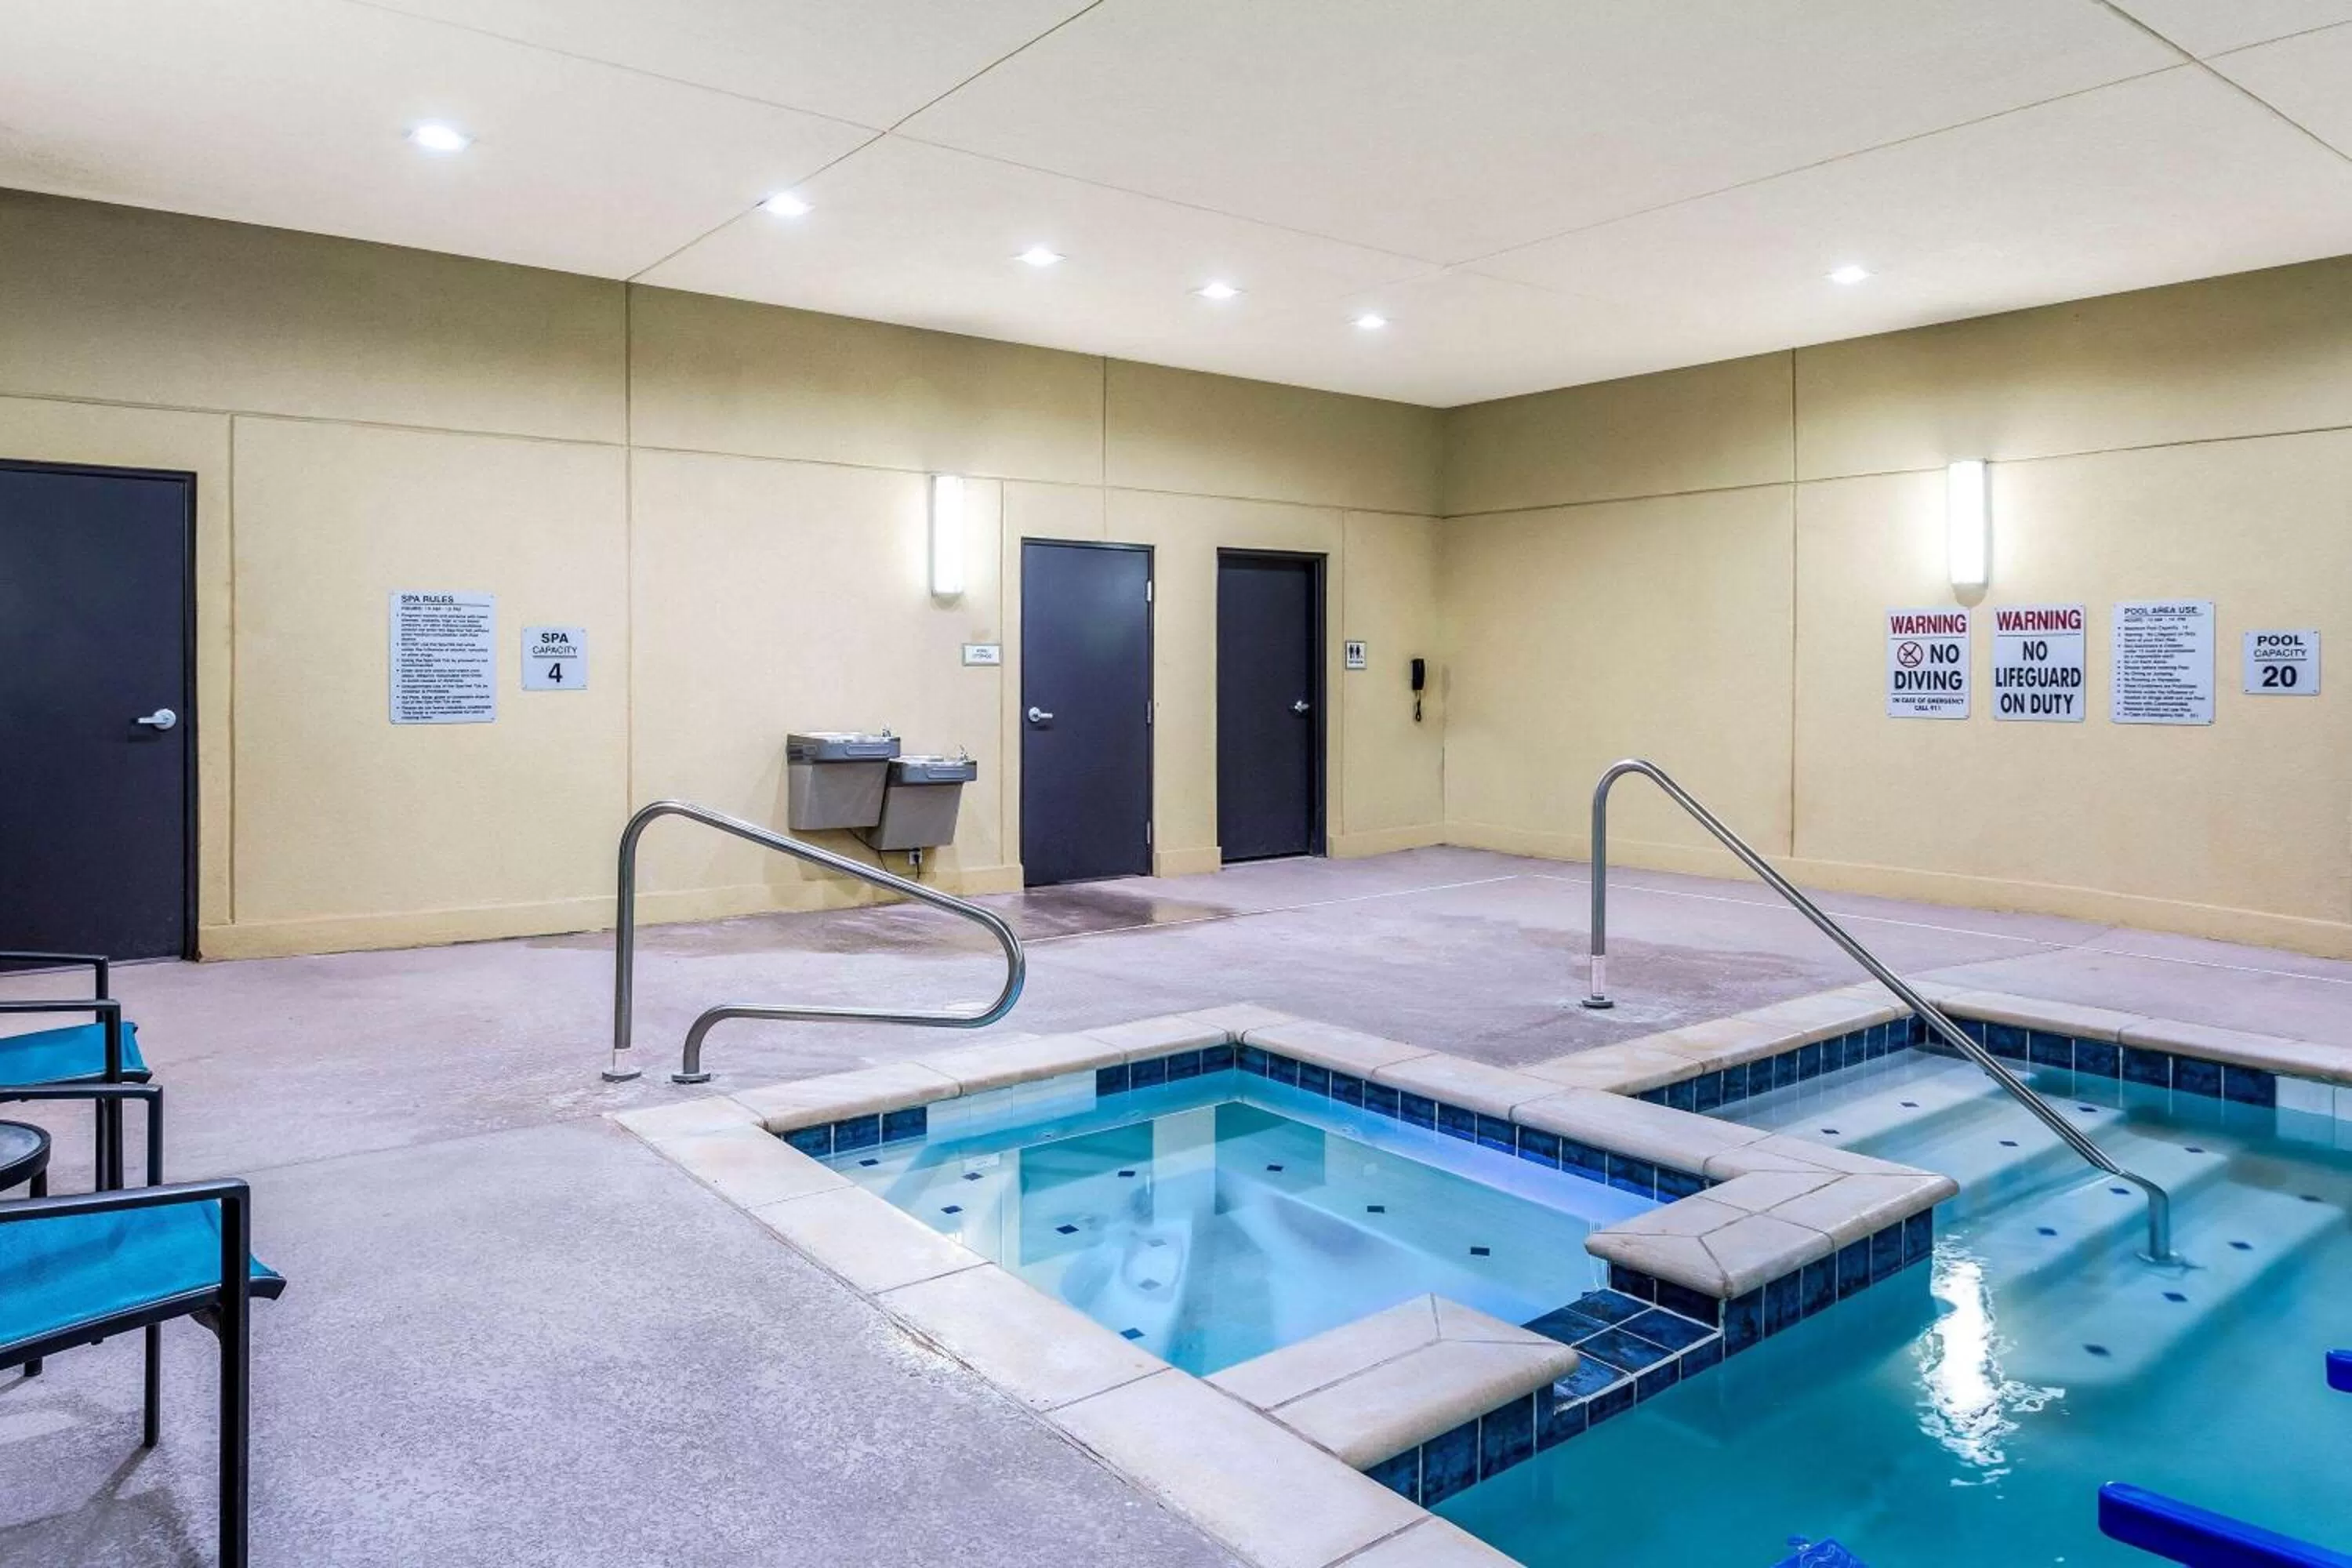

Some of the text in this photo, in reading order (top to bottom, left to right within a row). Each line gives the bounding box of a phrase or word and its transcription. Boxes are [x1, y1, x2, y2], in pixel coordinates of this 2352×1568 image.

[1890, 614, 1967, 634] WARNING
[1996, 609, 2082, 630] WARNING
[541, 633, 568, 643] SPA
[2257, 634, 2304, 646] POOL
[532, 645, 578, 655] CAPACITY
[1929, 644, 1960, 663] NO
[2022, 641, 2048, 661] NO
[2254, 648, 2307, 658] CAPACITY
[548, 662, 564, 683] 4
[1894, 670, 1963, 691] DIVING
[1994, 666, 2082, 688] LIFEGUARD
[2262, 665, 2298, 688] 20
[2000, 692, 2074, 714] ON DUTY
